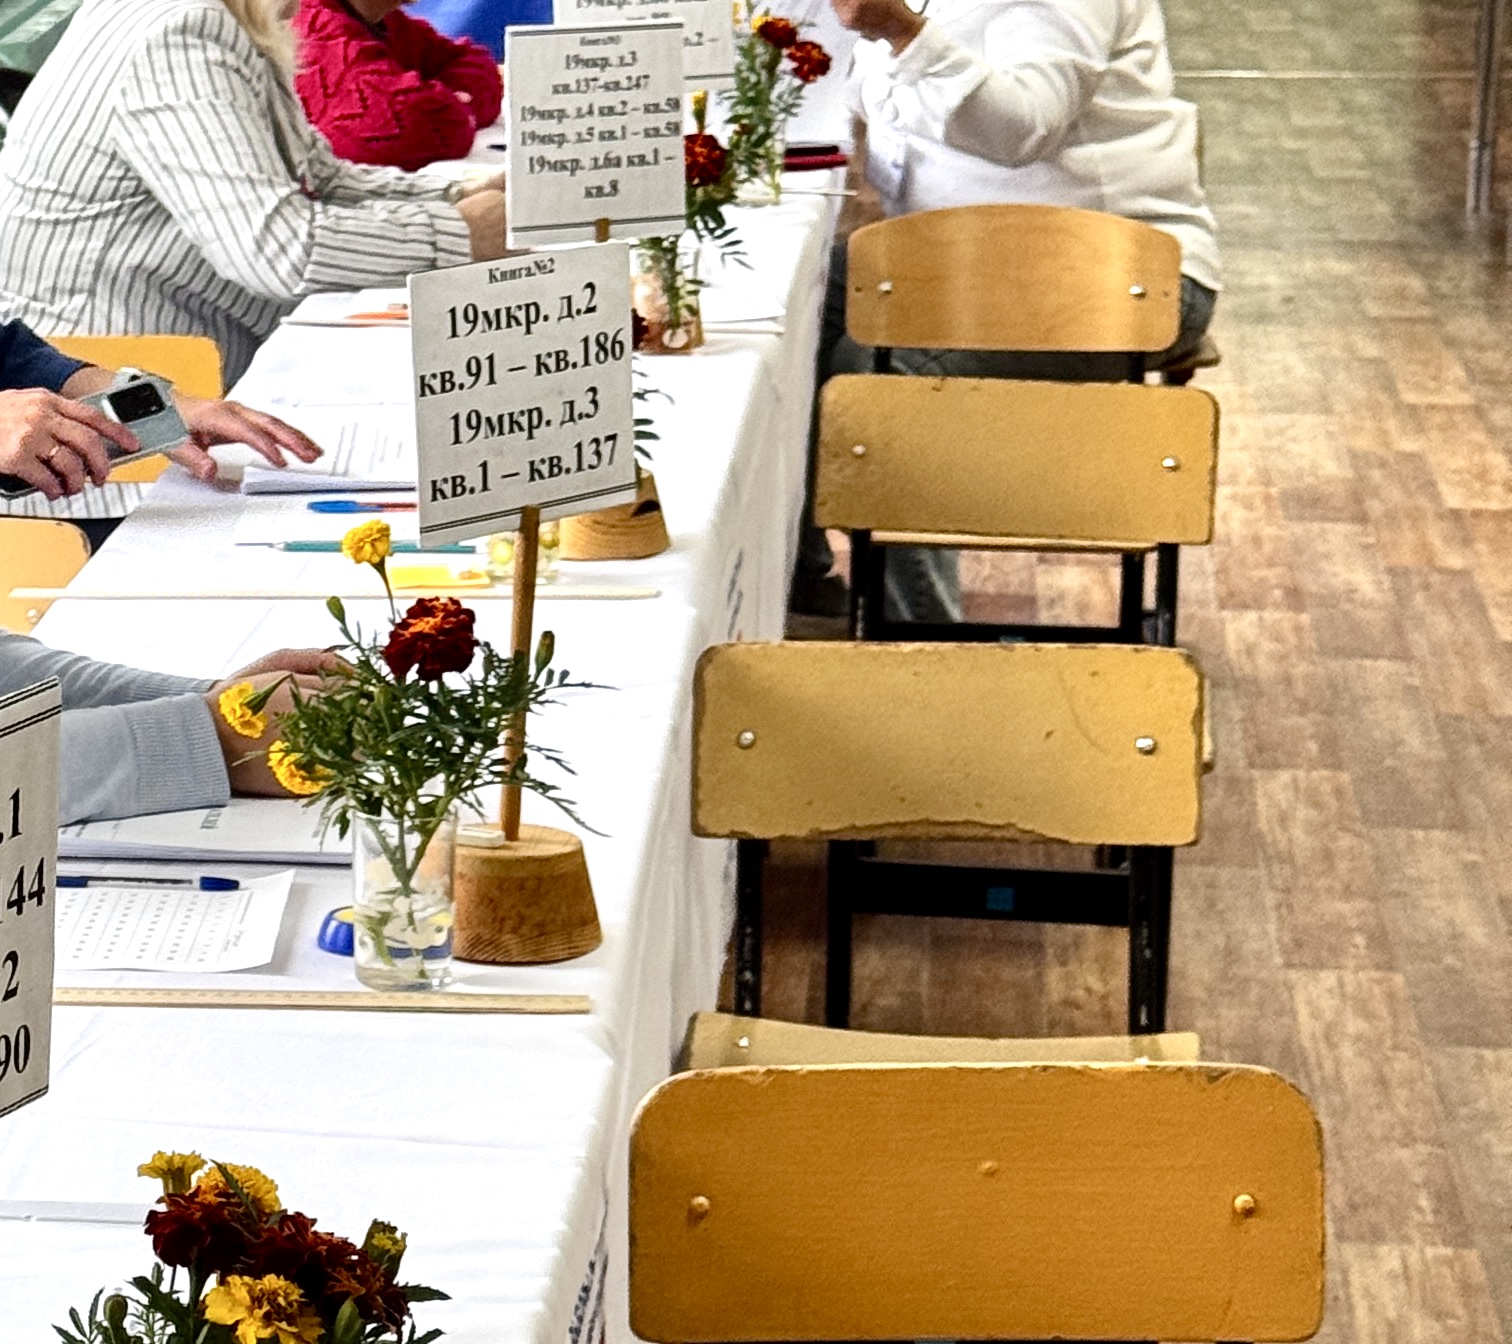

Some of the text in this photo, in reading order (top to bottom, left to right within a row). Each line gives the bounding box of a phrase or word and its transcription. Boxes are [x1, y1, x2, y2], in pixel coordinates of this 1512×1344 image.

[487, 258, 556, 284] Книга№2
[446, 281, 598, 339] 19мкр. д.2
[418, 352, 497, 397] кв.91
[534, 327, 625, 377] кв.186
[449, 386, 600, 446] 19мкр. д.3
[430, 460, 491, 502] кв.1
[527, 433, 618, 483] кв.137
